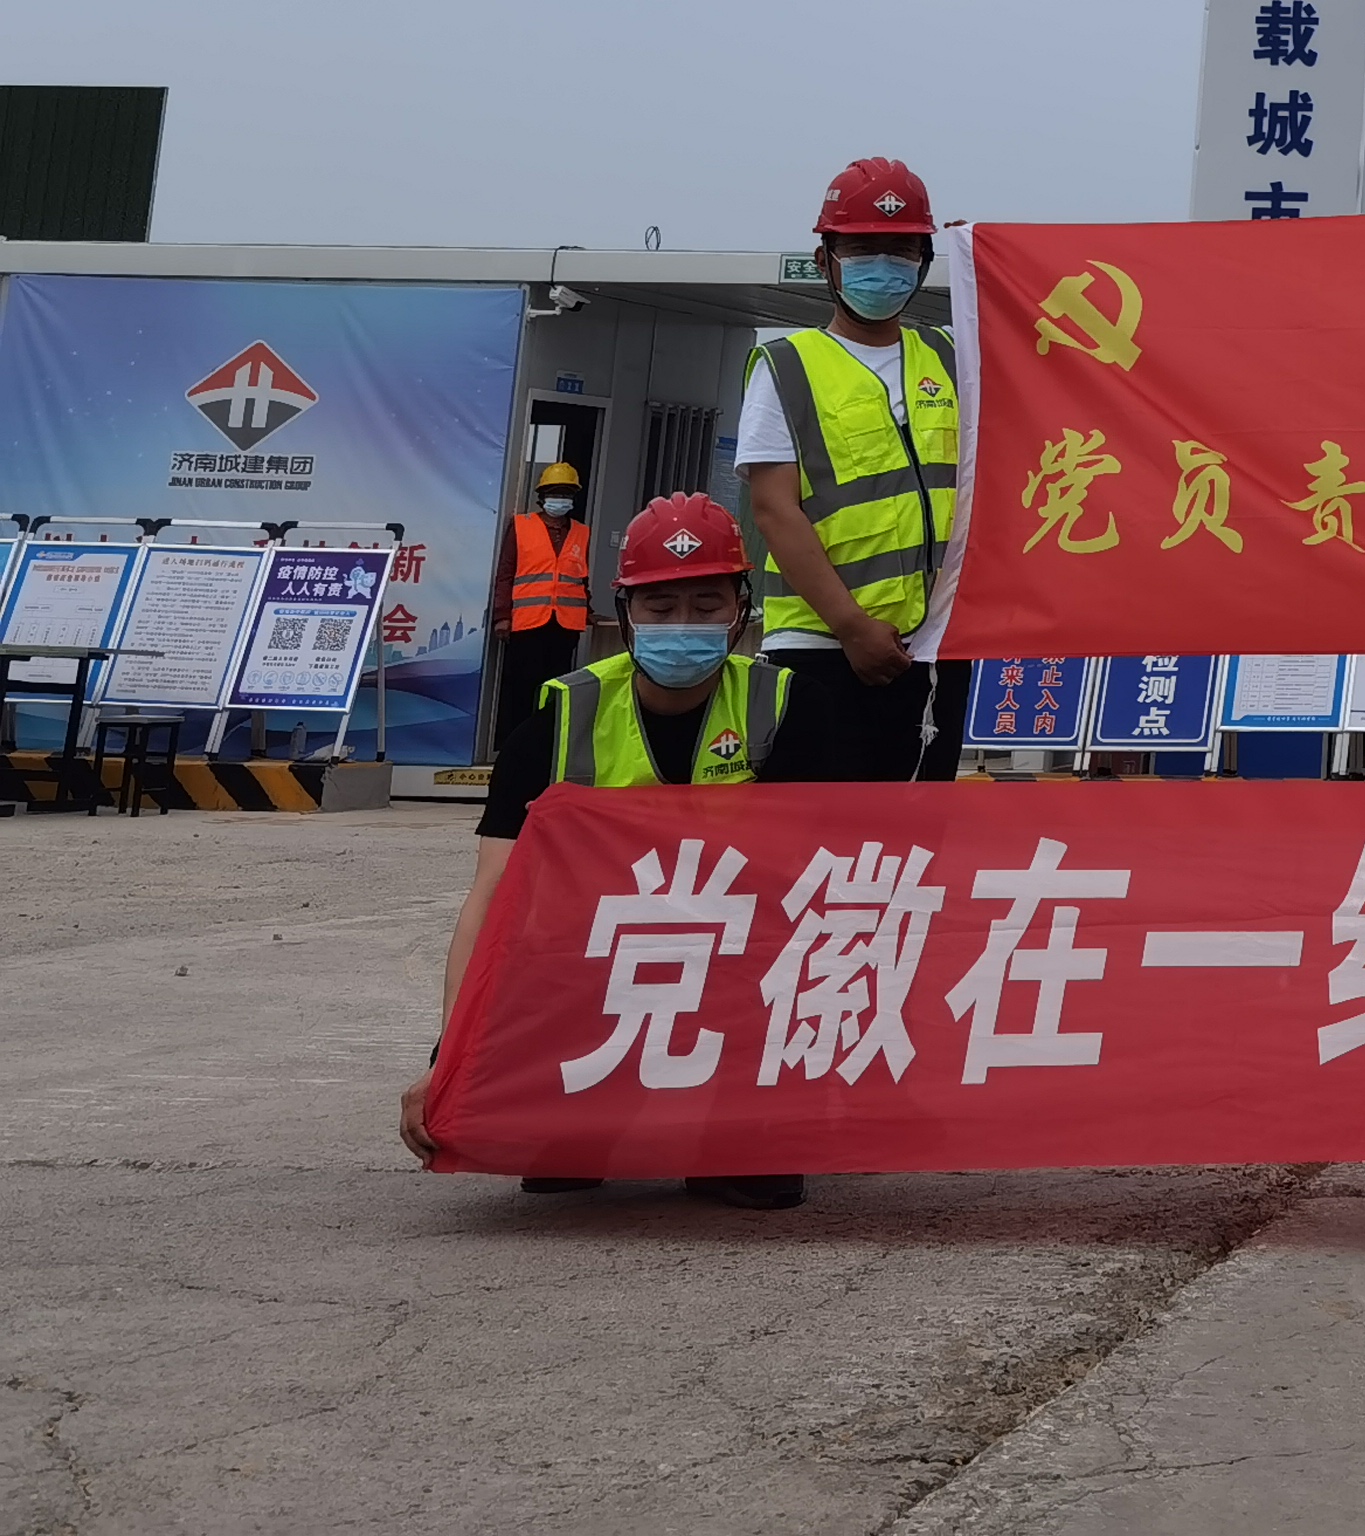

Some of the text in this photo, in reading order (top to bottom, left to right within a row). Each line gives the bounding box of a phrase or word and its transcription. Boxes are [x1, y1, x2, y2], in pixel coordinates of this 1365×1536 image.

[171, 452, 314, 475] 济南城建集团
[168, 476, 193, 488] JINAN
[276, 565, 339, 581] 疫情防控
[281, 581, 343, 597] 人人有责
[994, 657, 1023, 735] 来人员
